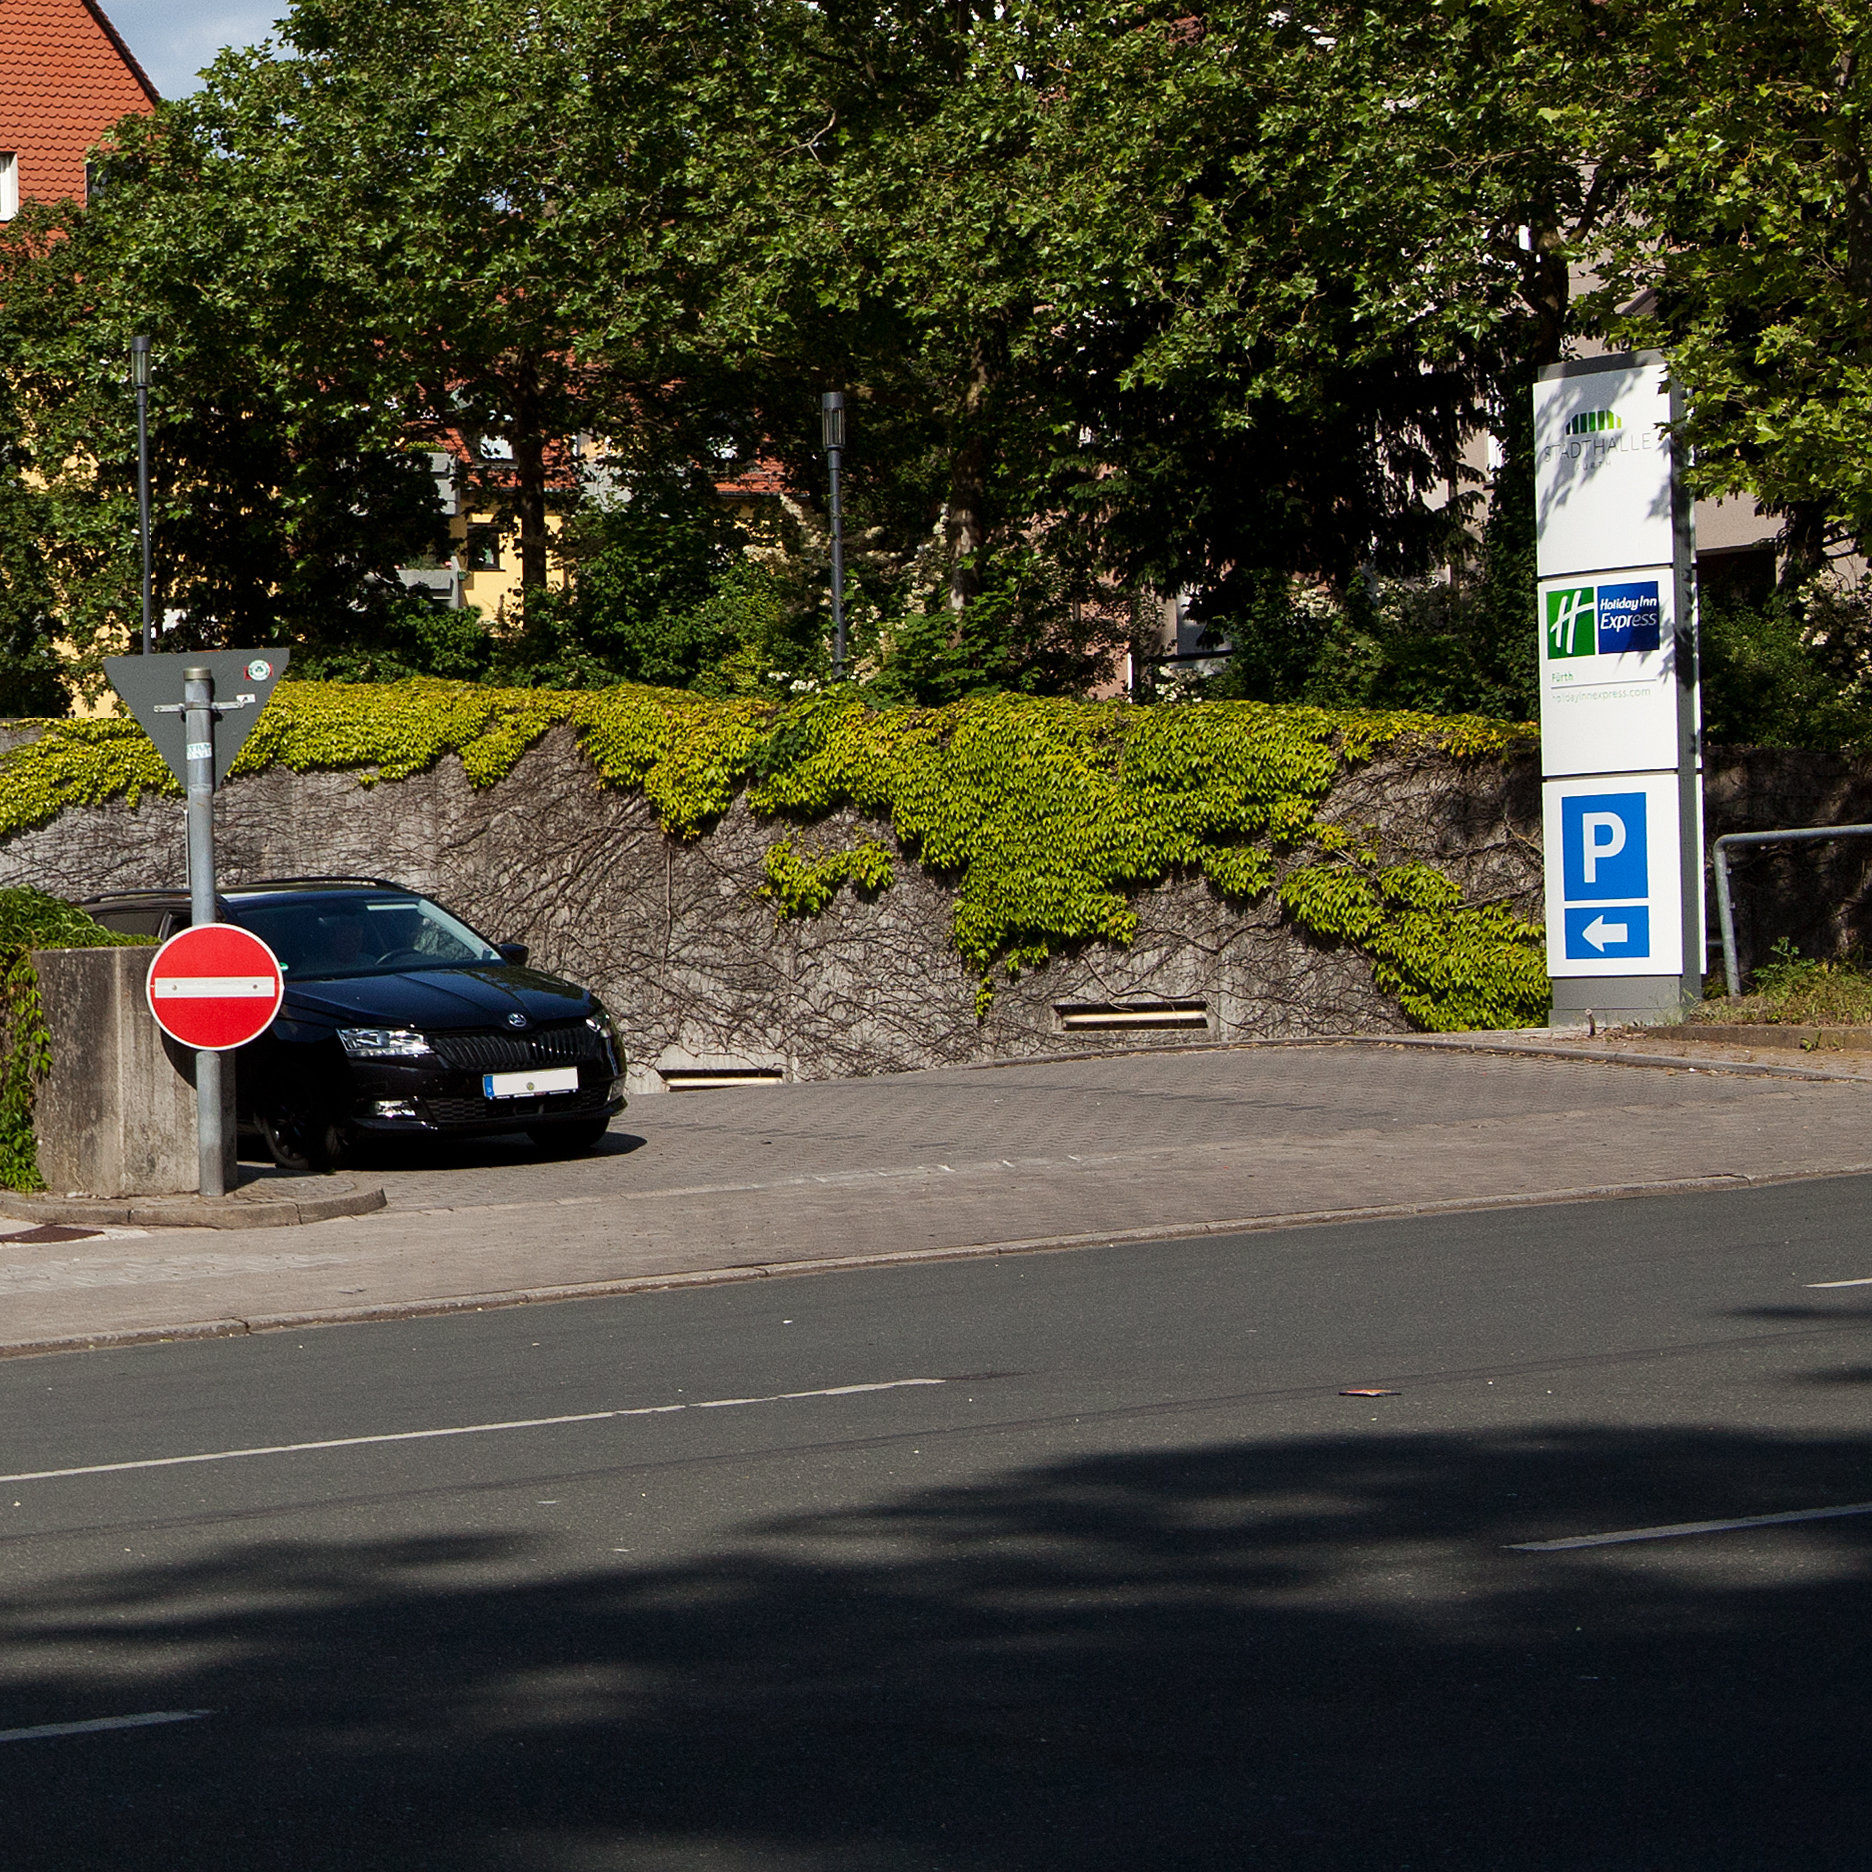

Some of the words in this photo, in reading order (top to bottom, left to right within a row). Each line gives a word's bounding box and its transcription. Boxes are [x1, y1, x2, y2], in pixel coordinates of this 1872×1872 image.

[1544, 432, 1652, 463] STADTHALLE
[1600, 596, 1638, 611] Holiday
[1639, 595, 1657, 607] Inn
[1600, 613, 1657, 633] Express
[1582, 810, 1626, 884] P
